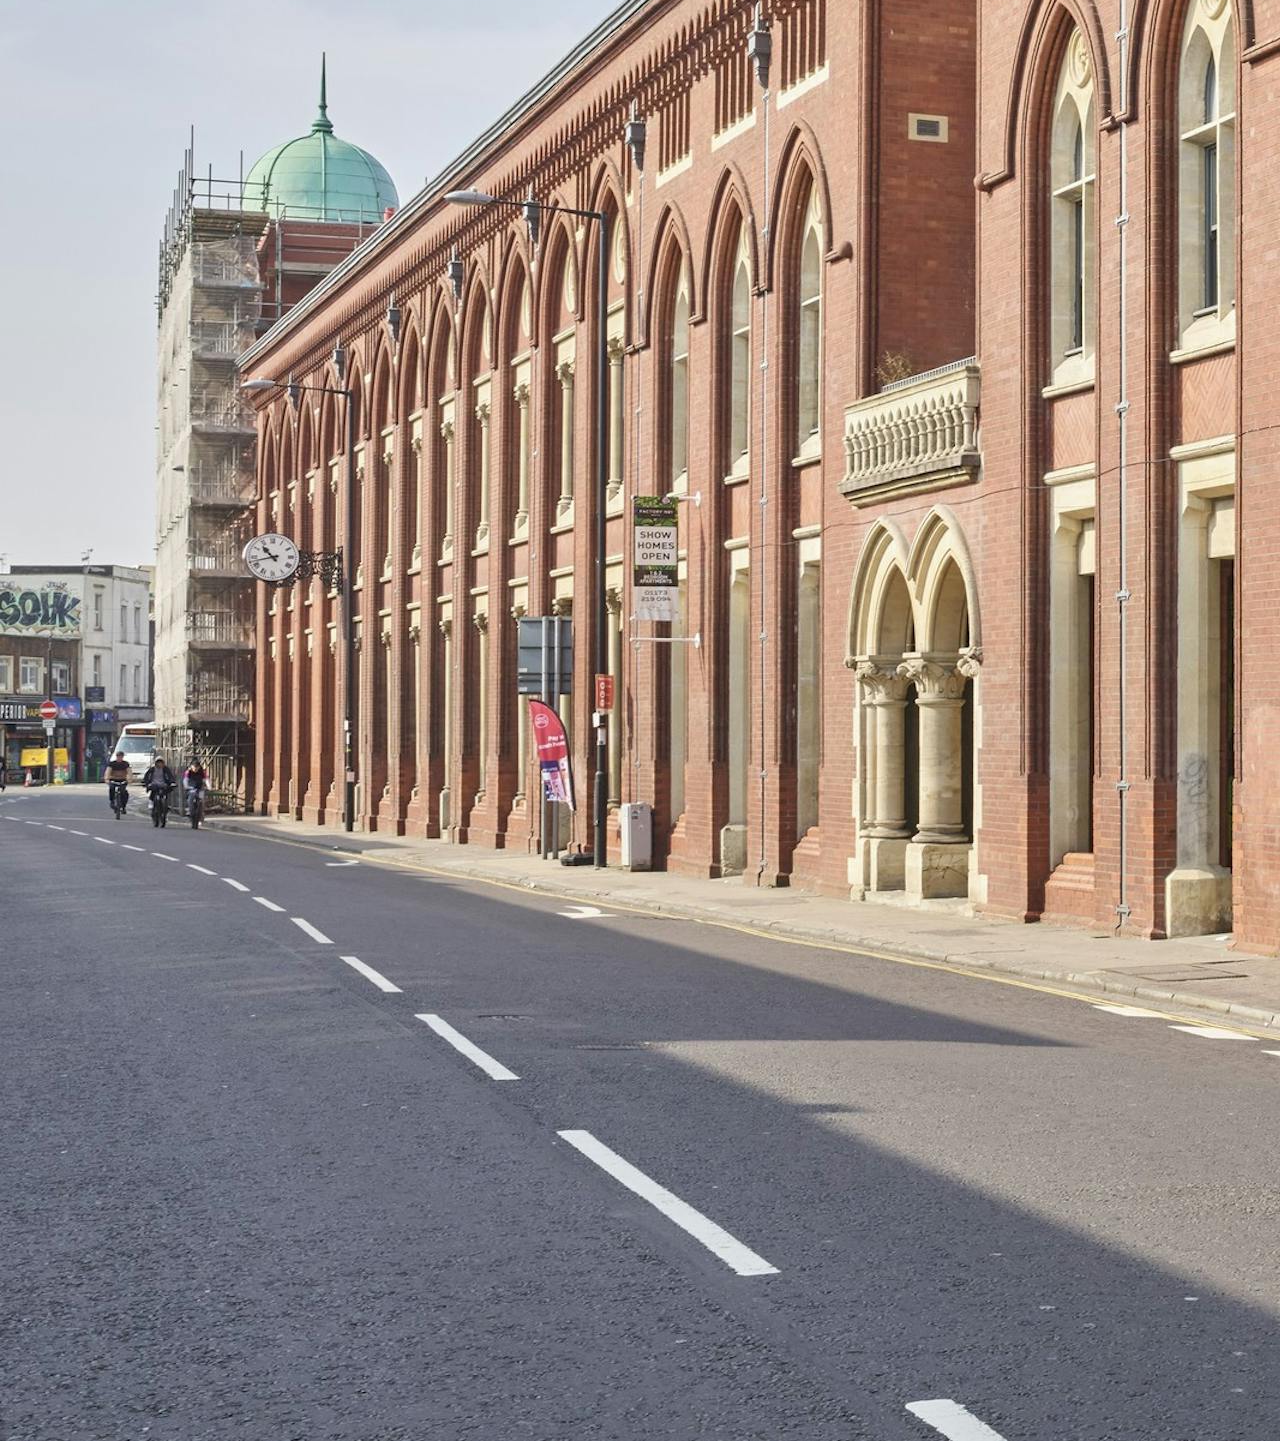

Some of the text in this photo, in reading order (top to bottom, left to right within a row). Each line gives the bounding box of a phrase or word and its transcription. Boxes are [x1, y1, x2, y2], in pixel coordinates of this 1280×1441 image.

[640, 530, 672, 539] SHOW
[638, 541, 675, 550] HOMES
[641, 552, 671, 560] OPEN
